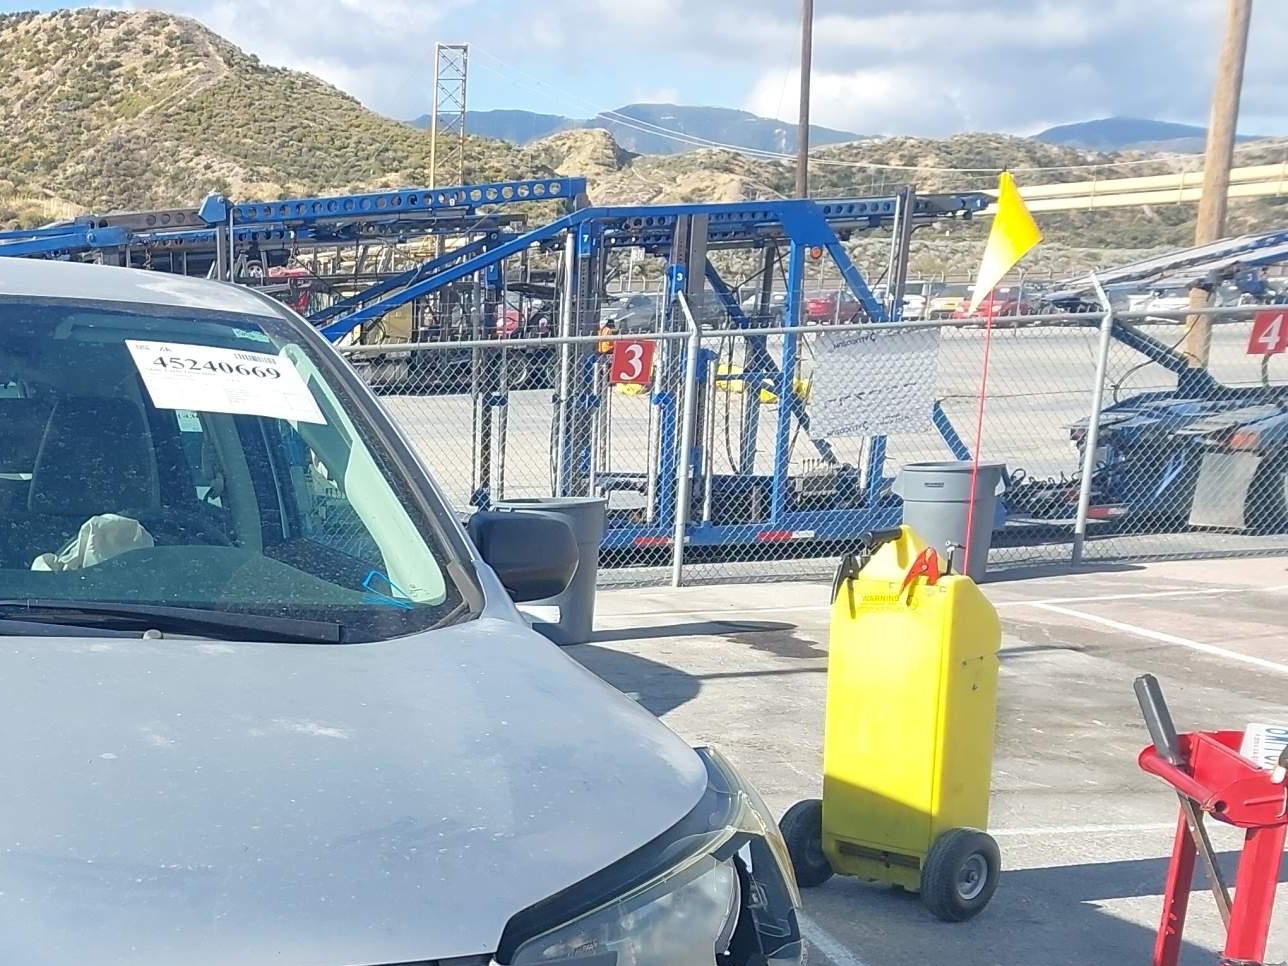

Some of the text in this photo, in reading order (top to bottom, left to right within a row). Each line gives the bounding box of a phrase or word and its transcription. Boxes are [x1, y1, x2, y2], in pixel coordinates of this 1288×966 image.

[583, 234, 589, 242] 7
[1258, 314, 1283, 350] 4
[152, 356, 281, 379] 45240669
[620, 344, 643, 380] 3
